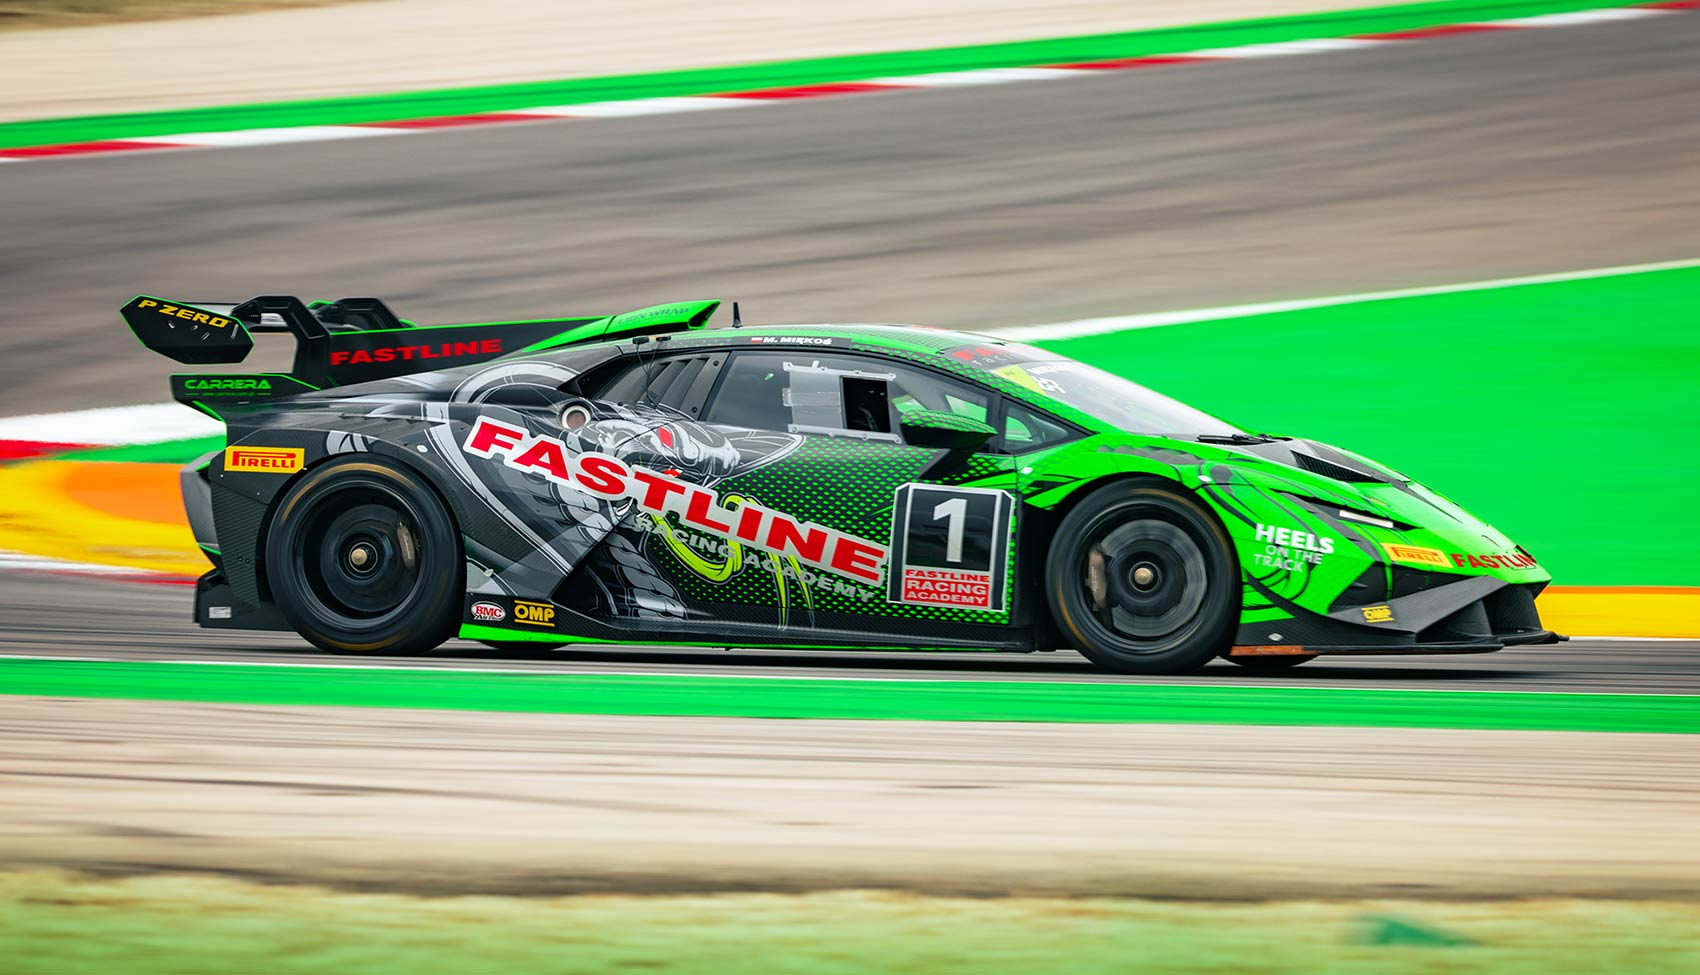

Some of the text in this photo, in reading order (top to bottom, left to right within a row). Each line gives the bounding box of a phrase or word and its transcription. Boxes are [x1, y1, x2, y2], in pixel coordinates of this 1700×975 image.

[138, 299, 230, 329] P ZERO
[763, 336, 779, 344] M.
[329, 339, 503, 366] FASTLINE
[184, 379, 272, 390] CARRERA
[231, 450, 297, 469] PIRELLI
[469, 420, 885, 582] FASTLINE
[933, 498, 968, 563] 1
[1255, 523, 1335, 555] HEELS
[634, 513, 875, 603] RACING ACADEMY
[1253, 553, 1303, 572] TRACK
[1265, 545, 1324, 565] ON THE
[1391, 546, 1444, 563] PIRELLI
[905, 569, 990, 583] FASTLINE
[906, 580, 987, 596] RACING
[906, 590, 986, 606] ACADEMY
[475, 606, 502, 618] BMC
[514, 604, 555, 622] OMP
